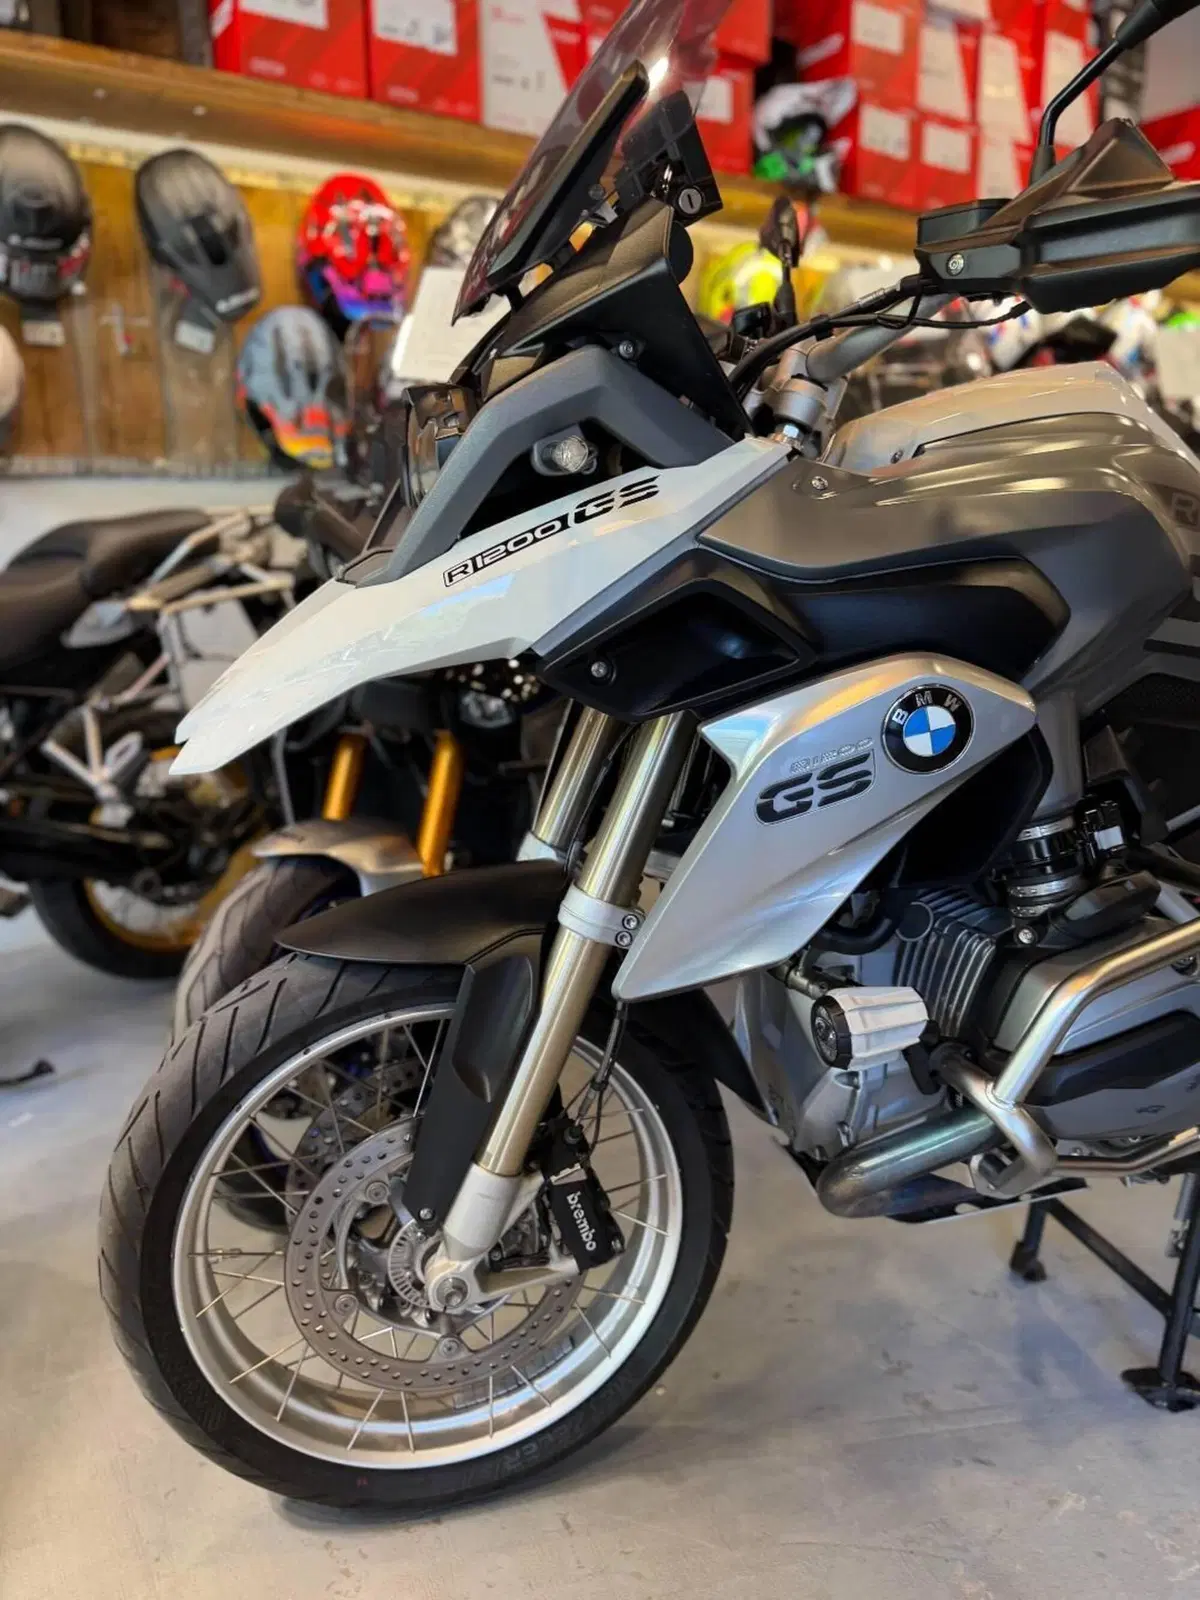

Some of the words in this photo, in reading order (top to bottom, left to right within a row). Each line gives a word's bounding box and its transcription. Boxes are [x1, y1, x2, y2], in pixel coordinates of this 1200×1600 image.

[574, 475, 660, 524] GS
[892, 690, 961, 725] BMW
[756, 752, 872, 823] GS
[566, 1191, 597, 1251] brembo
